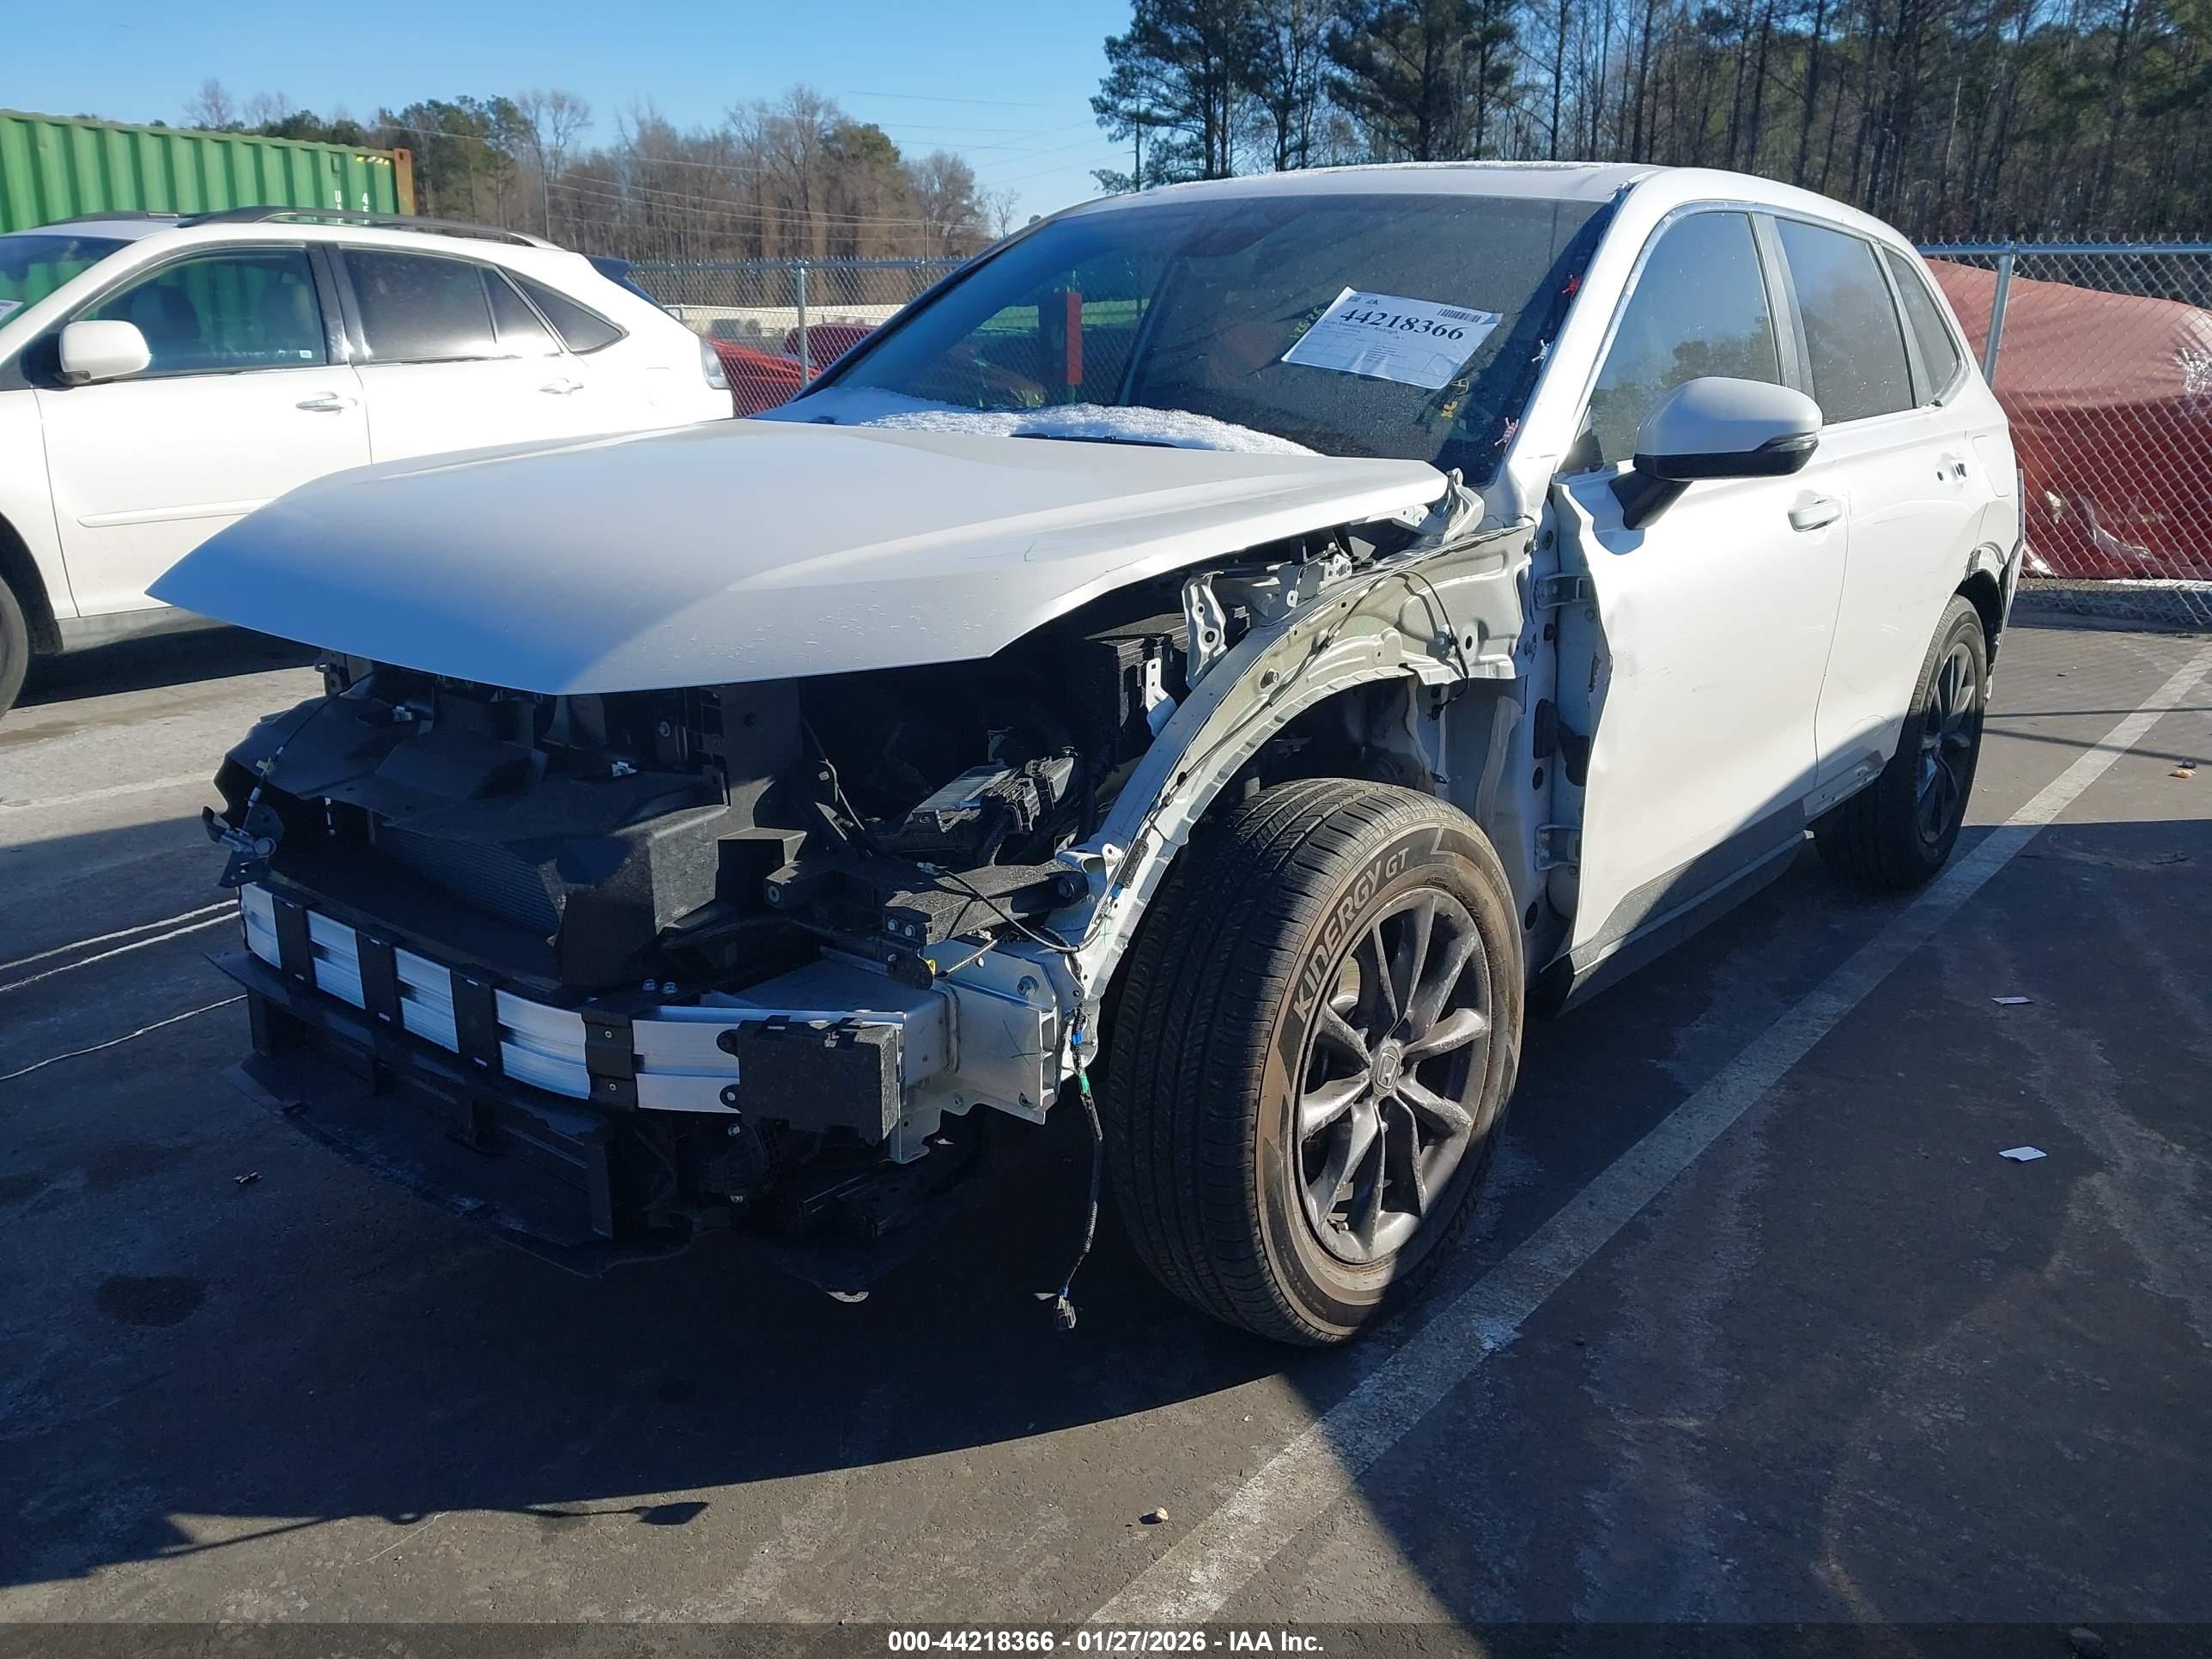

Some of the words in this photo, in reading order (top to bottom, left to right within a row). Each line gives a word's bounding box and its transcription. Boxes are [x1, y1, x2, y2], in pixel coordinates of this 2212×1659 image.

[1340, 308, 1468, 340] 44218366
[1292, 860, 1382, 1024] KINERGY
[1385, 847, 1410, 878] GT
